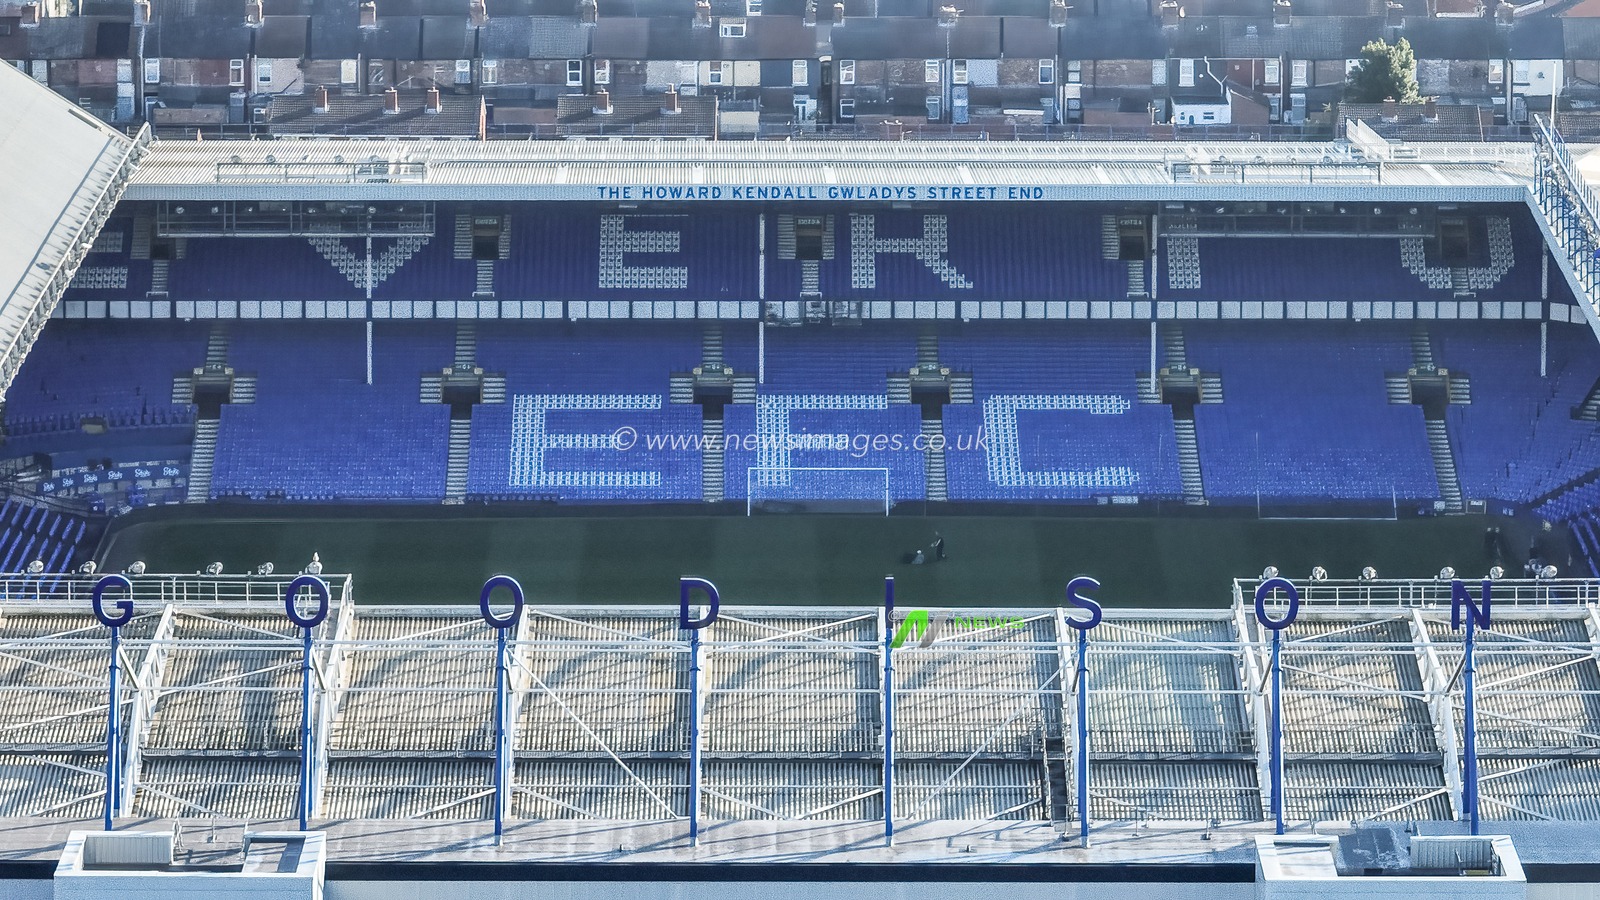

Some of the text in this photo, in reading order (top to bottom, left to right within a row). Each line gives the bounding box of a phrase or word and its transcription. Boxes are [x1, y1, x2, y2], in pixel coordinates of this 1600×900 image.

[597, 186, 1043, 199] THE HOWARD KENDALL GWLADYS STREET END
